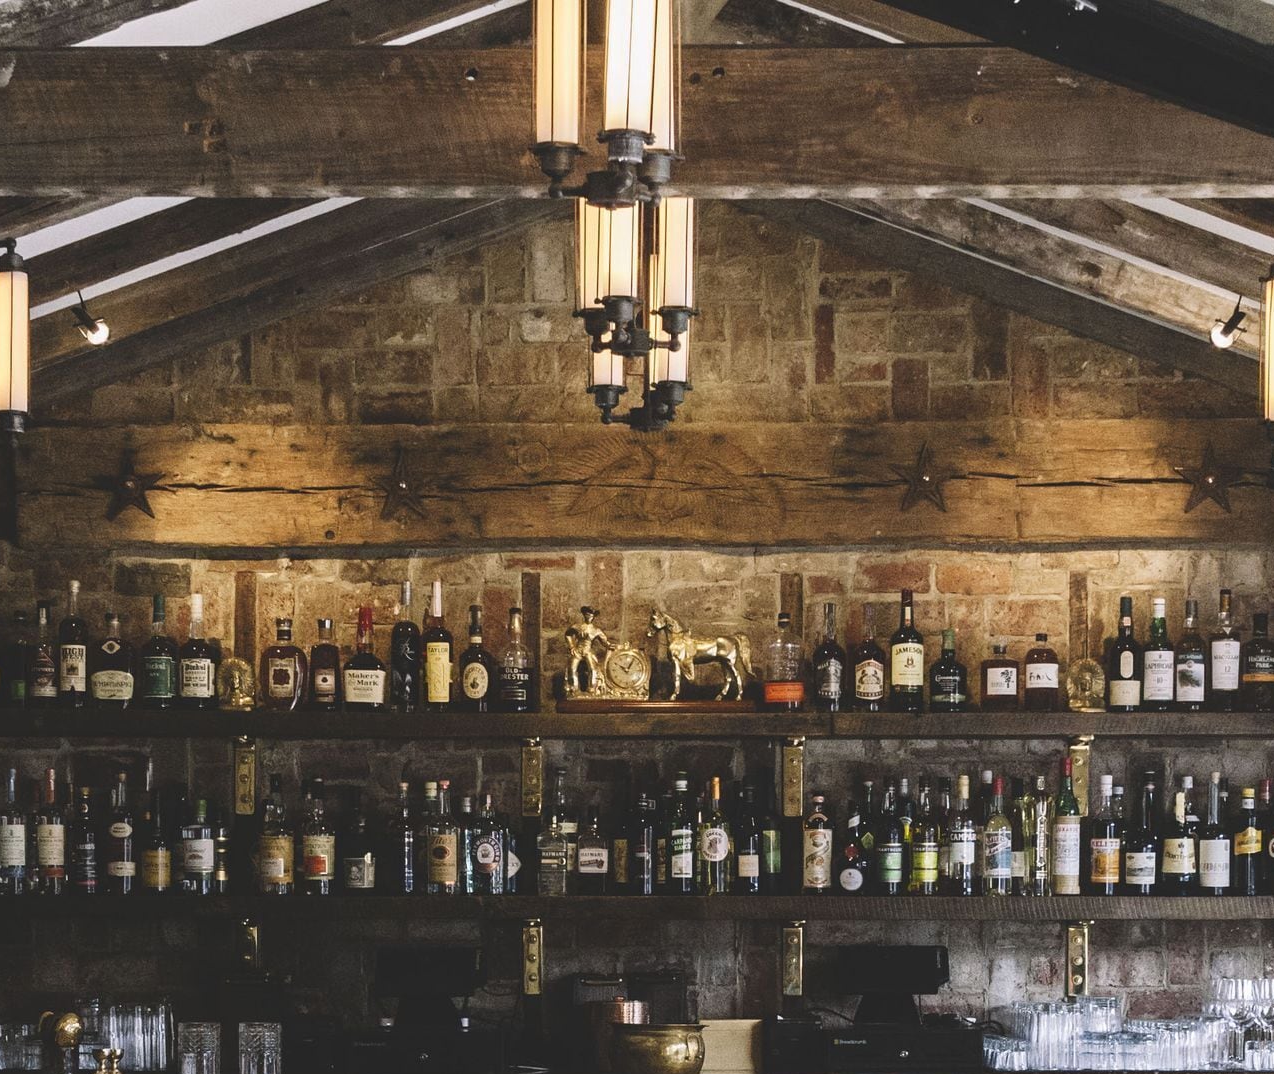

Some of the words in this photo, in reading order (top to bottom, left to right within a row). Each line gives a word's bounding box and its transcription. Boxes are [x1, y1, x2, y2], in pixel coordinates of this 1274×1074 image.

[61, 647, 84, 656] HIGH
[895, 647, 923, 656] JAMESON
[347, 672, 380, 680] Maker's
[357, 679, 379, 687] Mark
